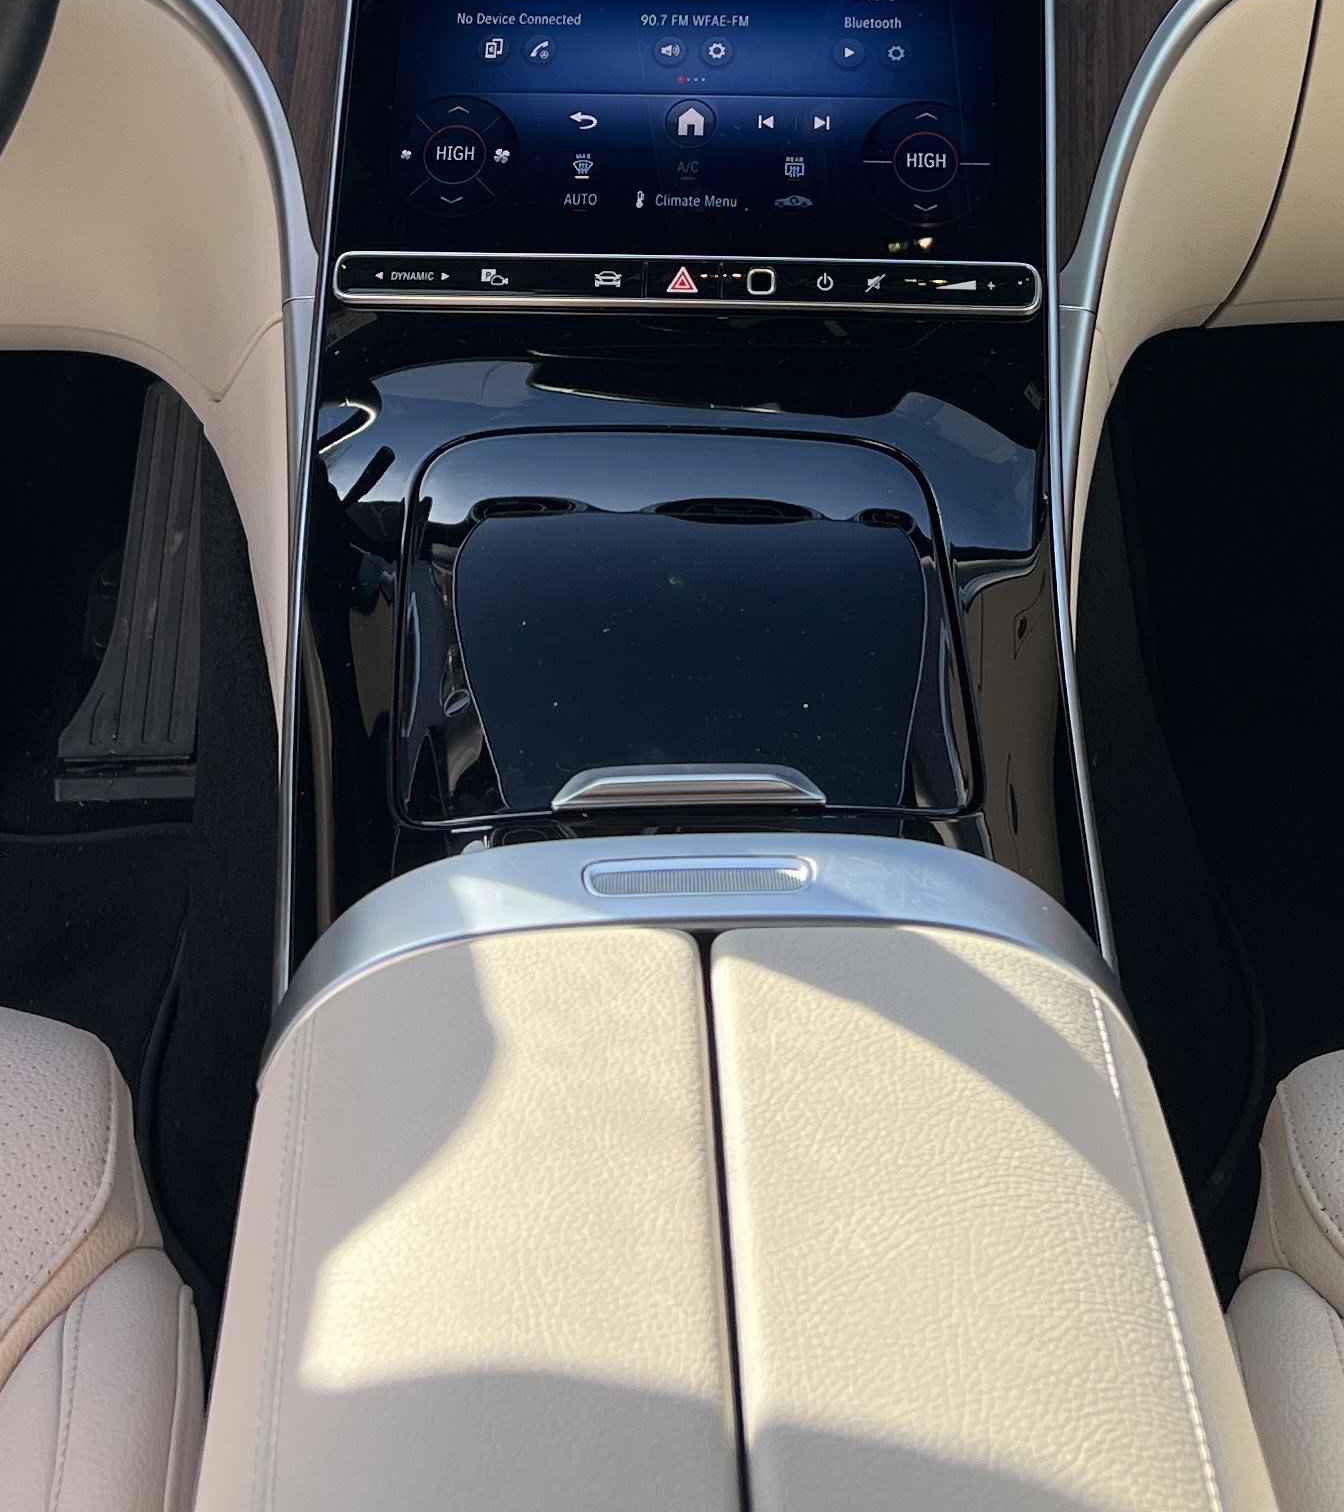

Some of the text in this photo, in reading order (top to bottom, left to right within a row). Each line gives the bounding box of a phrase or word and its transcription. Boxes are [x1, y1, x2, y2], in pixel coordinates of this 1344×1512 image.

[457, 13, 582, 26] No Device Connected
[641, 14, 749, 28] 90.7 FM WFAE-FM
[844, 16, 902, 30] Bluetooth
[436, 145, 475, 162] HIGH
[677, 161, 699, 174] A/C
[906, 152, 946, 170] HIGH
[564, 193, 598, 206] AUTO
[655, 194, 738, 208] Climate Menu
[390, 271, 435, 281] DYNAMIC
